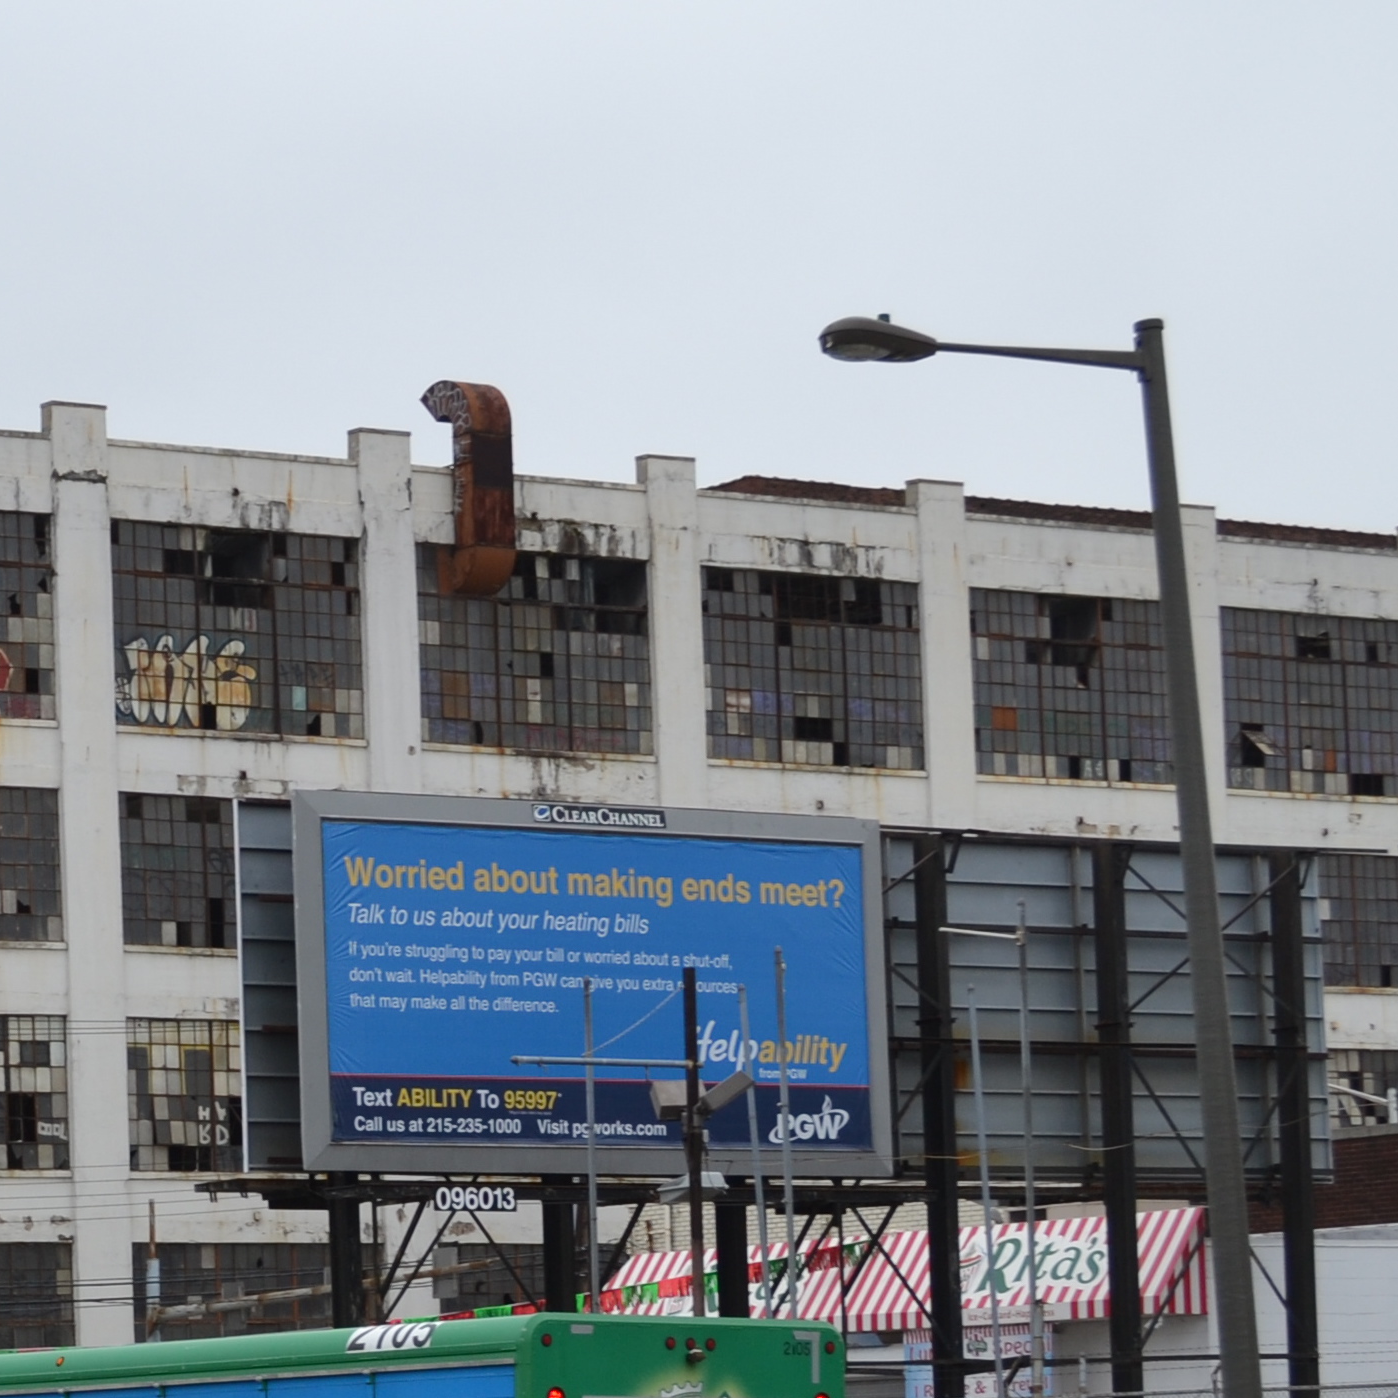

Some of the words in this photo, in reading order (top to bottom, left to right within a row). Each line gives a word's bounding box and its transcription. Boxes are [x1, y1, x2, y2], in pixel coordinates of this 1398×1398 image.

[343, 856, 464, 890] Worried
[474, 862, 559, 895] about
[568, 867, 673, 907] making
[681, 873, 752, 904] ends
[759, 879, 845, 908] meet?
[348, 903, 385, 924] Talk
[389, 905, 408, 925] to
[413, 909, 436, 926] us
[441, 907, 493, 929] about
[497, 912, 538, 933] your
[543, 910, 610, 937] heating
[614, 913, 650, 935] bills
[349, 941, 358, 956] If
[360, 942, 402, 959] you're
[405, 944, 469, 963] struggling
[472, 946, 485, 960] to
[487, 949, 511, 964] pay
[514, 949, 543, 964] your
[546, 947, 564, 962] bill
[567, 951, 581, 963] or
[583, 950, 630, 966] worried
[634, 951, 669, 967] about
[673, 956, 681, 967] a
[683, 952, 733, 970] shut-off,
[349, 968, 383, 982] don't
[386, 969, 416, 984] wait.
[420, 970, 488, 987] Helpability
[490, 972, 520, 986] from
[523, 972, 557, 987] PGW
[560, 976, 583, 989] can
[588, 975, 613, 992] give
[616, 980, 640, 993] you
[642, 979, 673, 992] extra
[349, 994, 376, 1008] that
[379, 998, 406, 1012] may
[410, 996, 447, 1010] make
[450, 997, 466, 1010] all
[468, 997, 489, 1011] the
[492, 998, 559, 1012] difference.
[353, 1087, 393, 1107] Text
[397, 1088, 472, 1108] ABILITY
[477, 1089, 499, 1109] To
[354, 1116, 382, 1132] Call
[387, 1120, 405, 1133] us
[409, 1119, 423, 1133] at
[427, 1118, 521, 1134] 215-235-1000
[537, 1119, 569, 1135] Visit
[572, 1120, 666, 1139] pgworks.com
[776, 1113, 842, 1140] PGW
[436, 1186, 516, 1211] 096013
[976, 1237, 1105, 1294] Rita's
